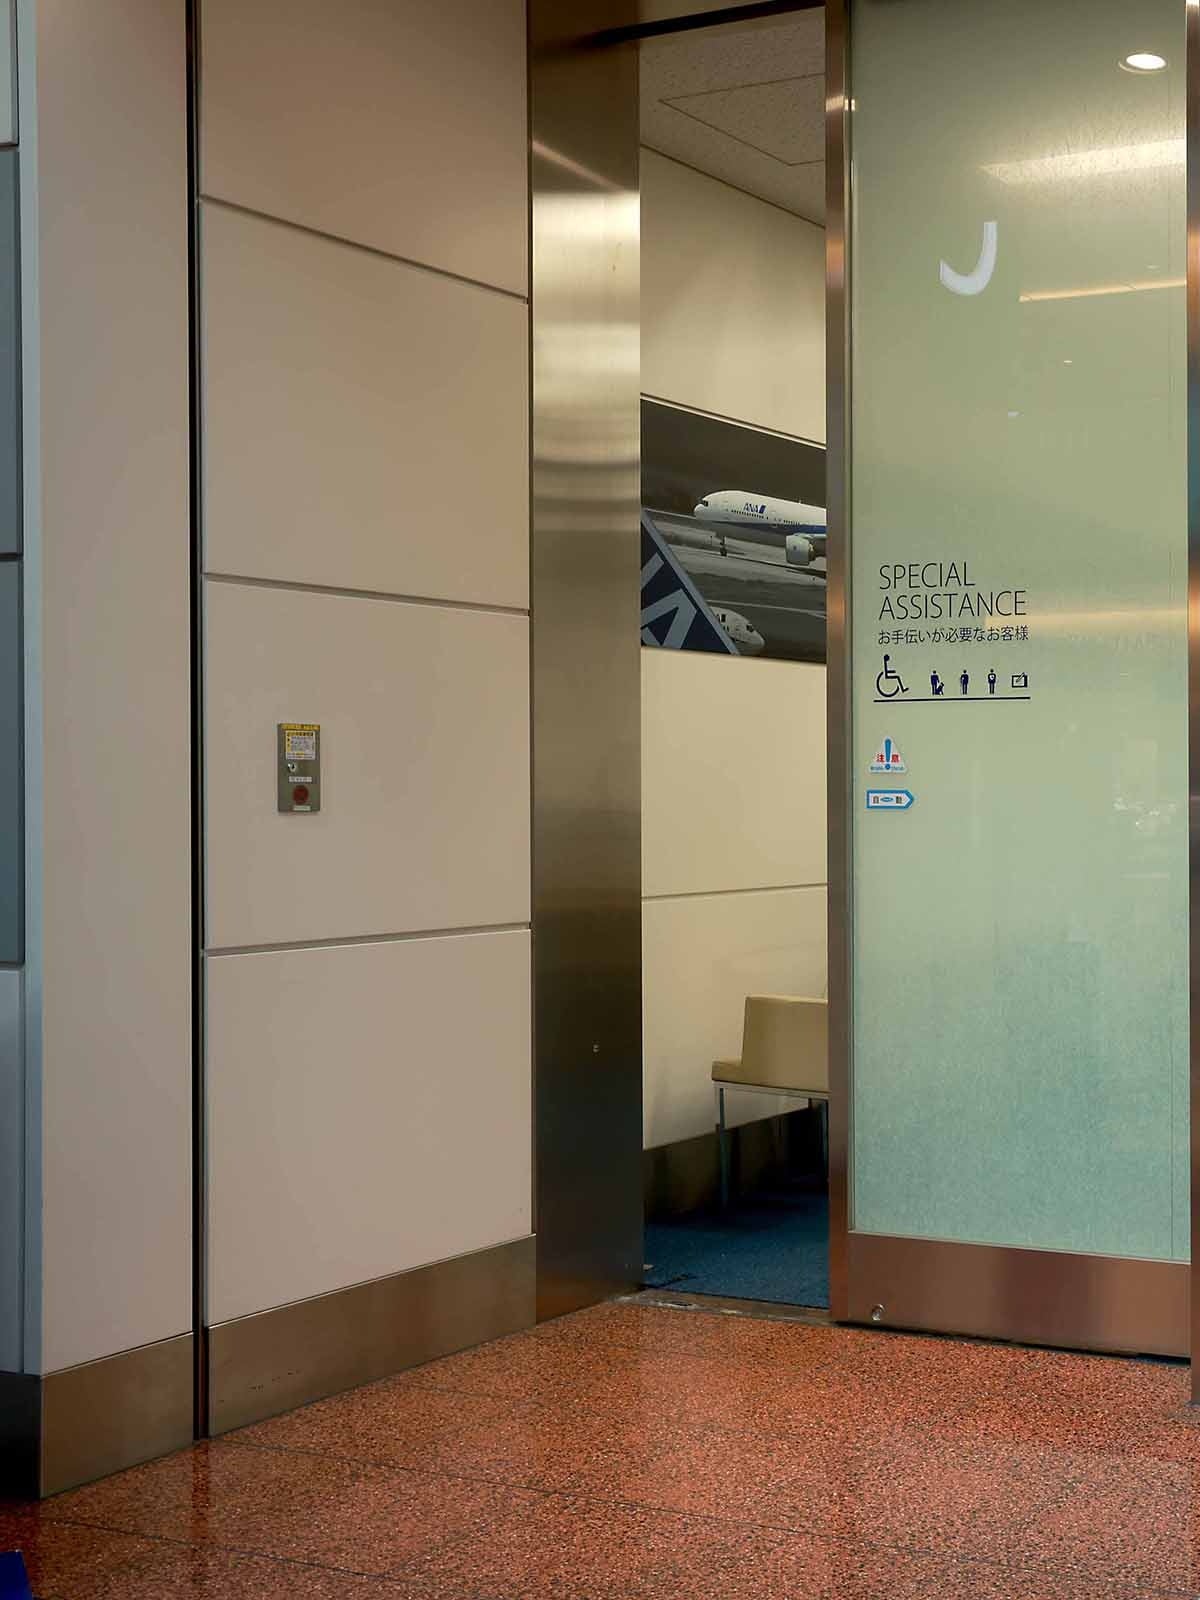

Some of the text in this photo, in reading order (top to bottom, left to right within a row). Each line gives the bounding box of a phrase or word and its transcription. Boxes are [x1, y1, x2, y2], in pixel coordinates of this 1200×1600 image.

[879, 561, 976, 590] SPECIAL
[878, 590, 1027, 621] ASSISTANCE
[878, 624, 1029, 645] お手伝いが必要なお客様
